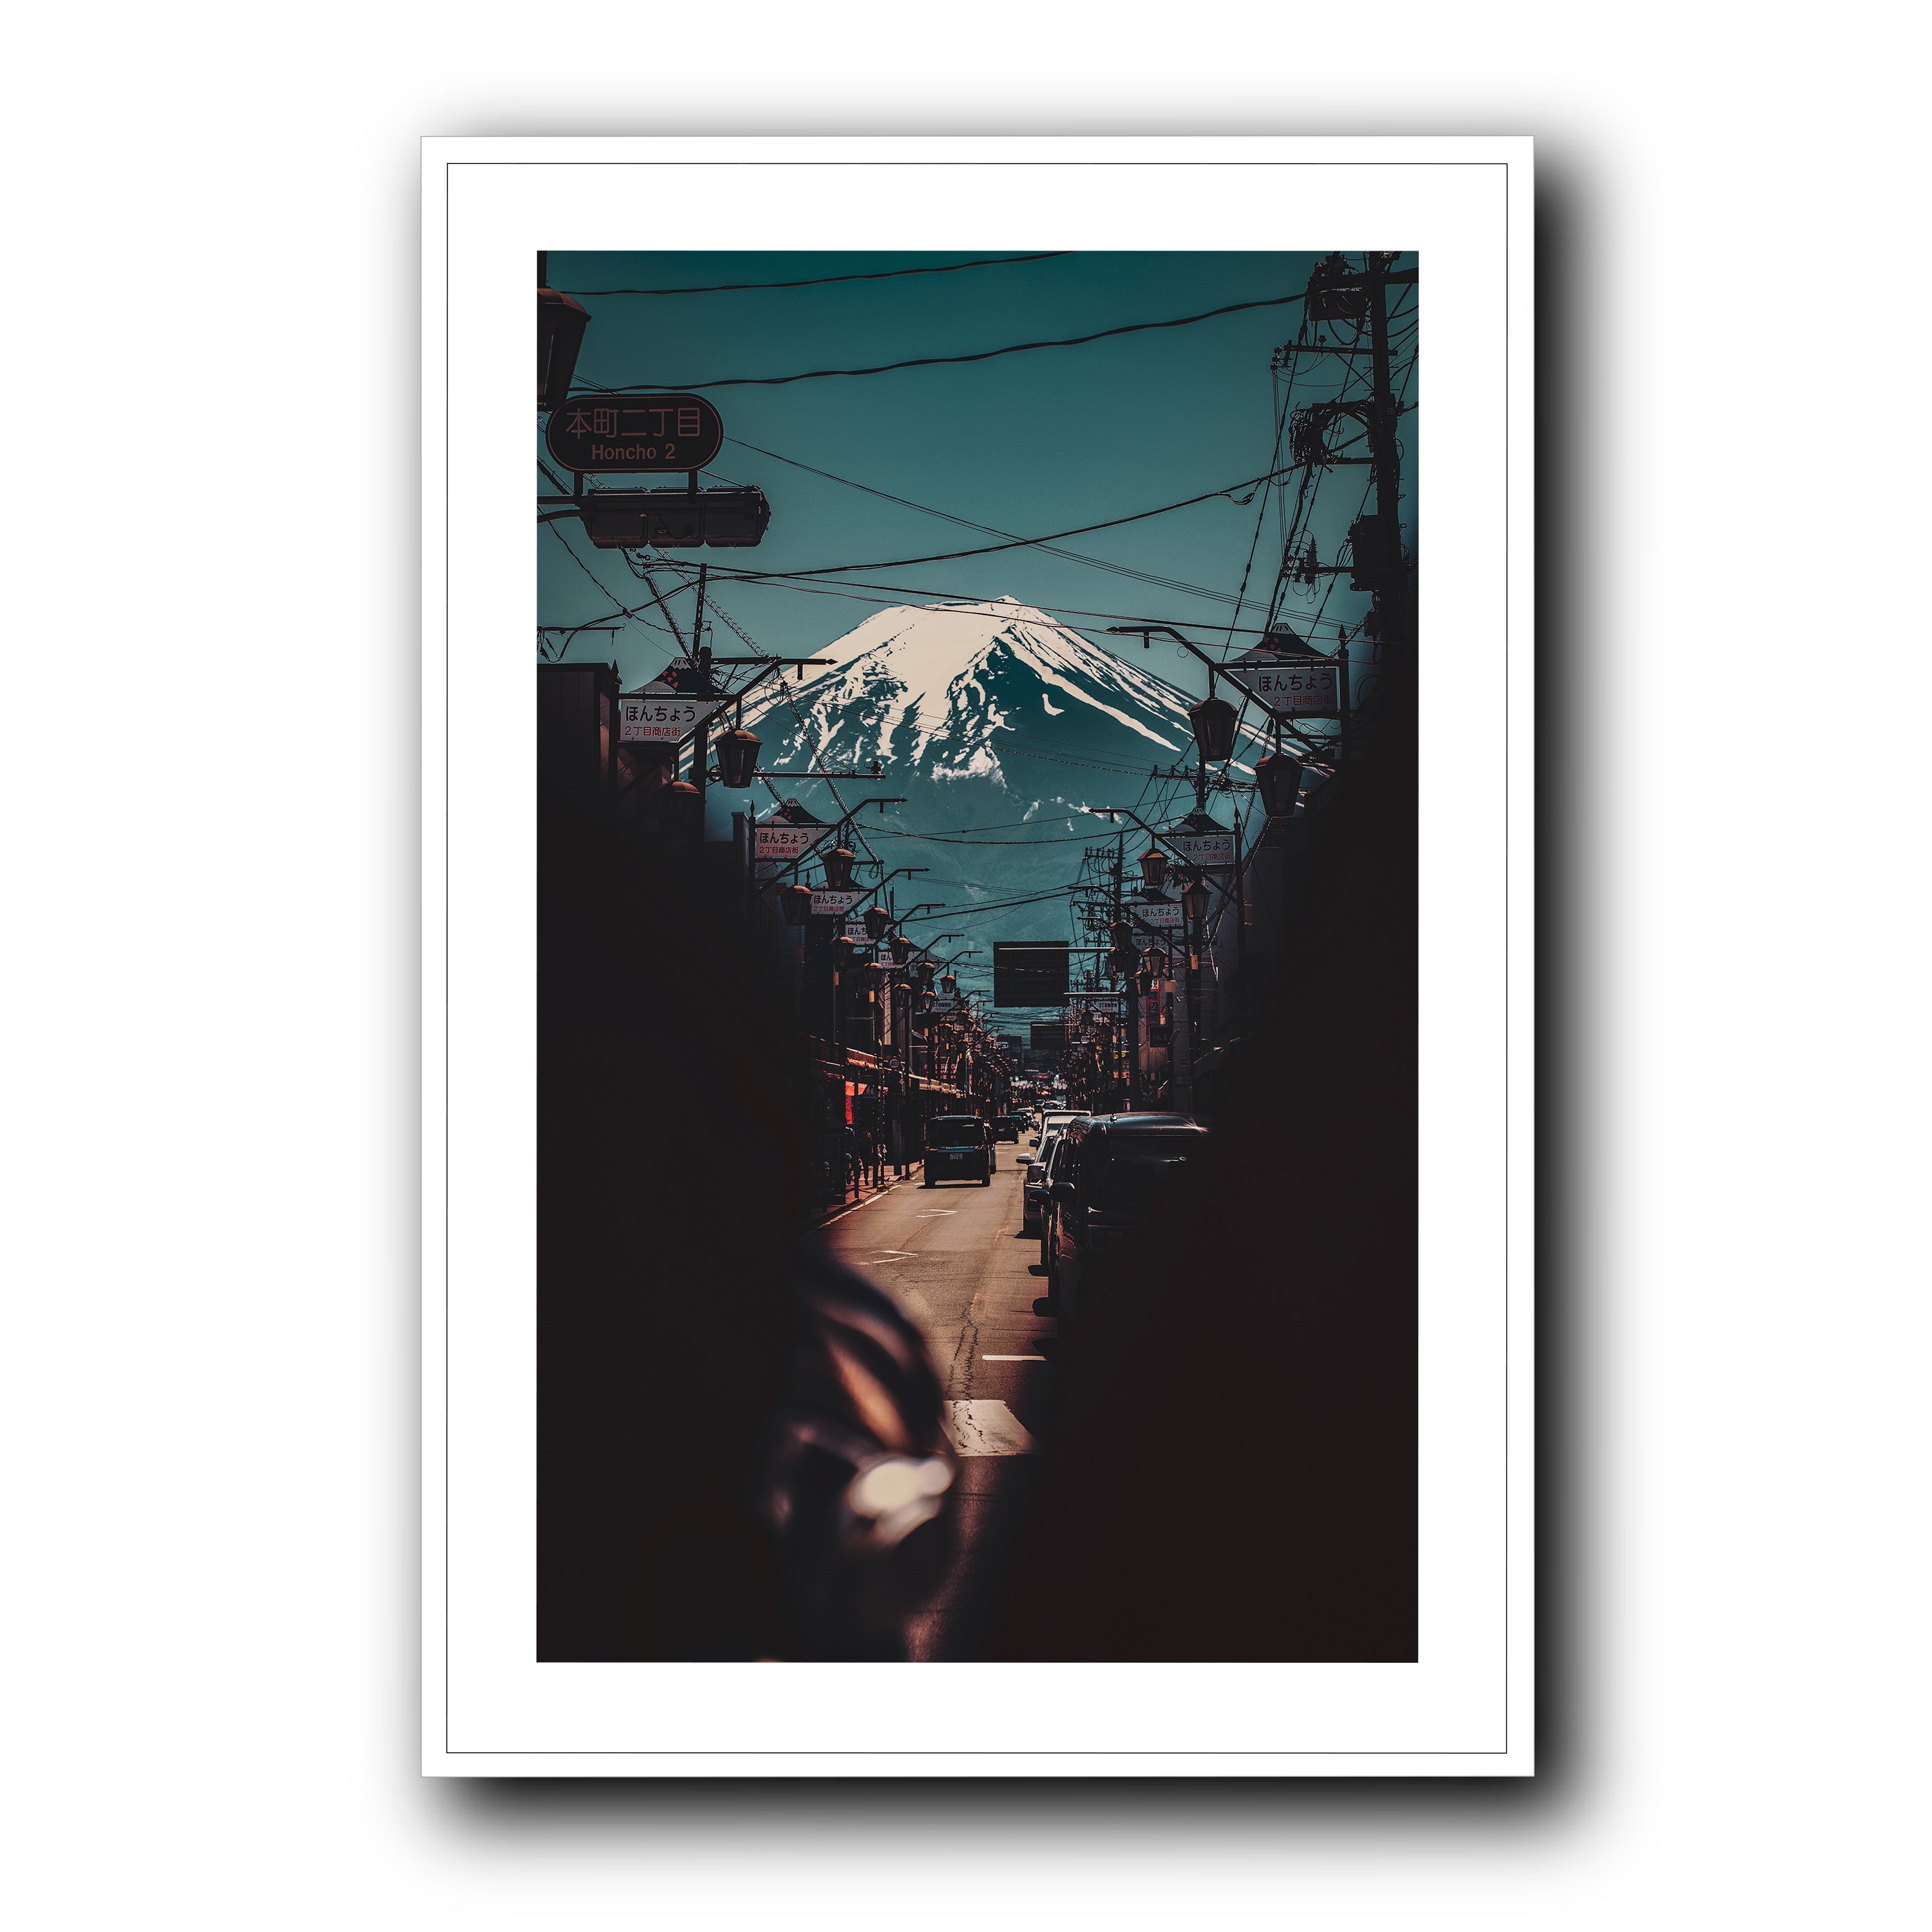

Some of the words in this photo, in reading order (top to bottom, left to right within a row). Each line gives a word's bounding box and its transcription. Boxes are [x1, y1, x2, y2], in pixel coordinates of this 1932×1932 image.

[565, 407, 701, 439] 本町二丁目
[592, 444, 657, 460] Honcho
[665, 443, 676, 459] 2
[1258, 673, 1333, 692] ほんちょう
[625, 705, 696, 723] ほんちょう
[625, 726, 681, 737] 2丁目商店街
[759, 831, 809, 844] ほんちょう
[1182, 838, 1231, 852] ほんちょう
[814, 895, 853, 905] ほんちょう
[1142, 906, 1179, 917] ほんちょう
